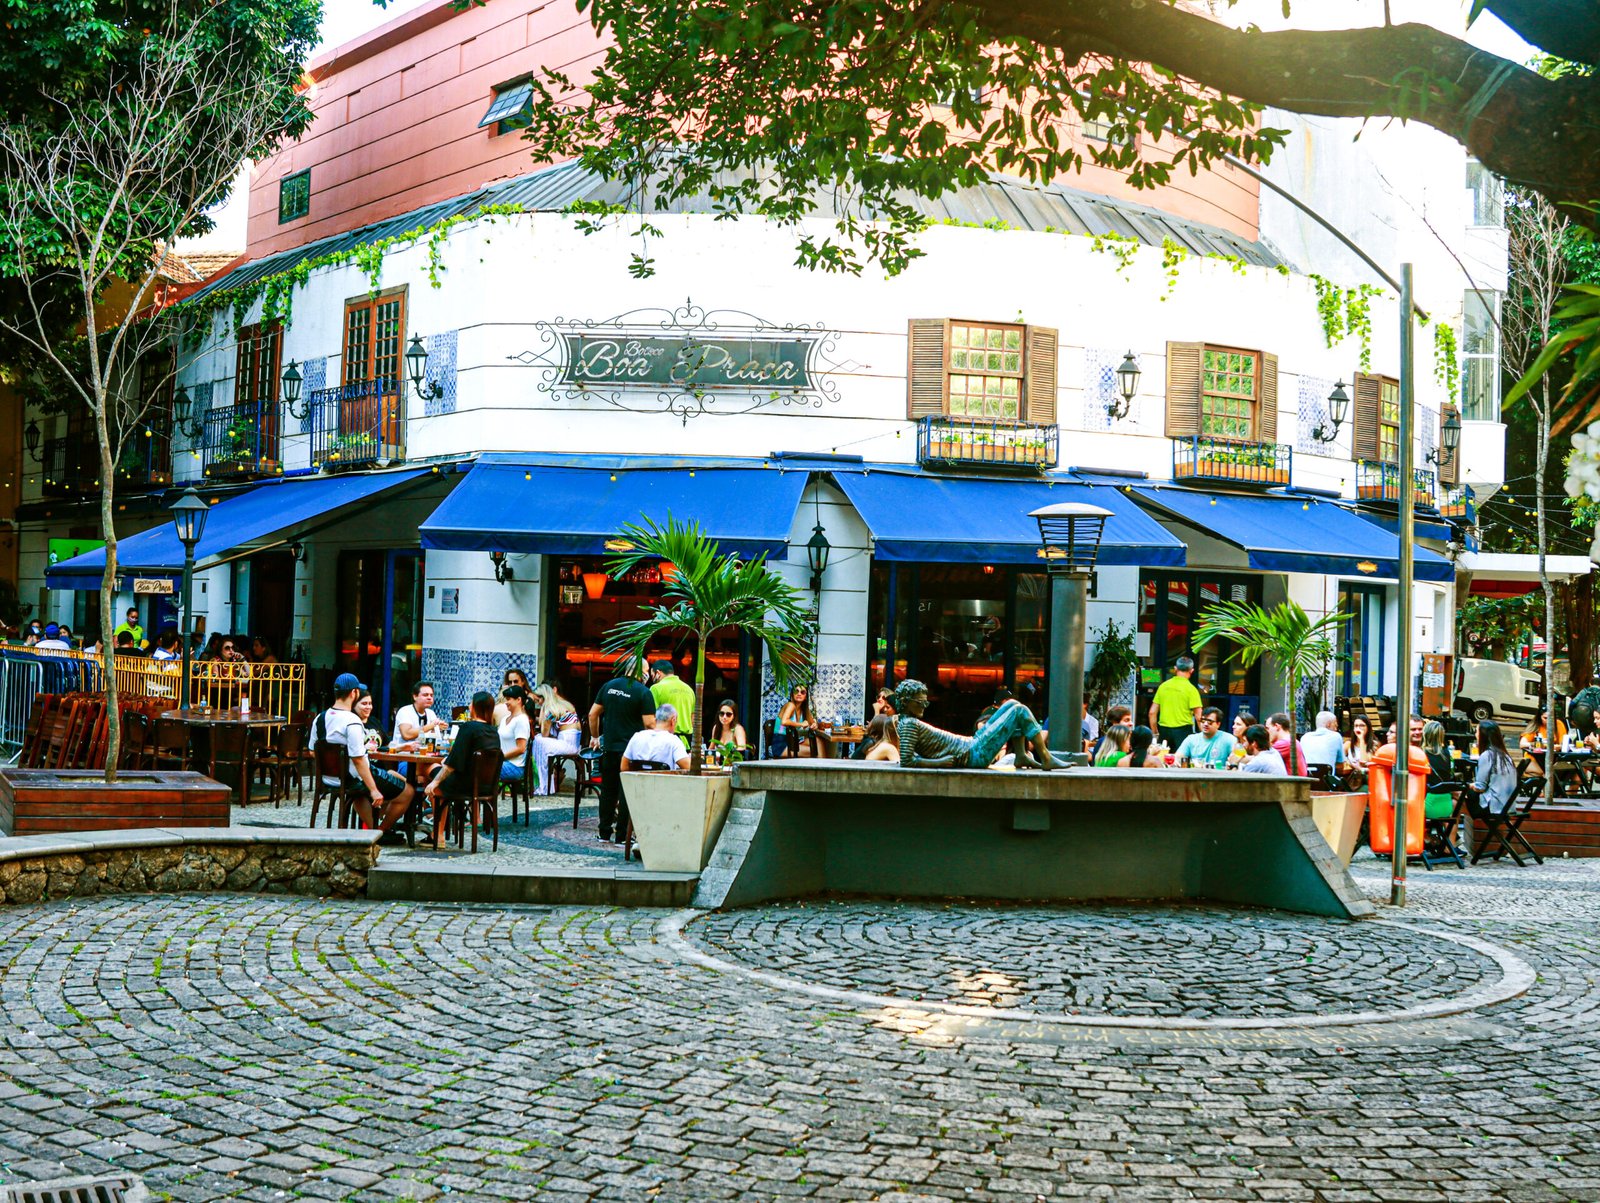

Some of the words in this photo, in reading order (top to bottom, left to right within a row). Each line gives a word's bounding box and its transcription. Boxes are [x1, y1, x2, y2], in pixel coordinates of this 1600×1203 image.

[623, 340, 665, 357] Boteco
[574, 340, 655, 379] Boa
[669, 344, 801, 383] Praça
[136, 580, 151, 592] Boa
[1000, 1029, 1045, 1039] EM
[1061, 1034, 1109, 1043] UM
